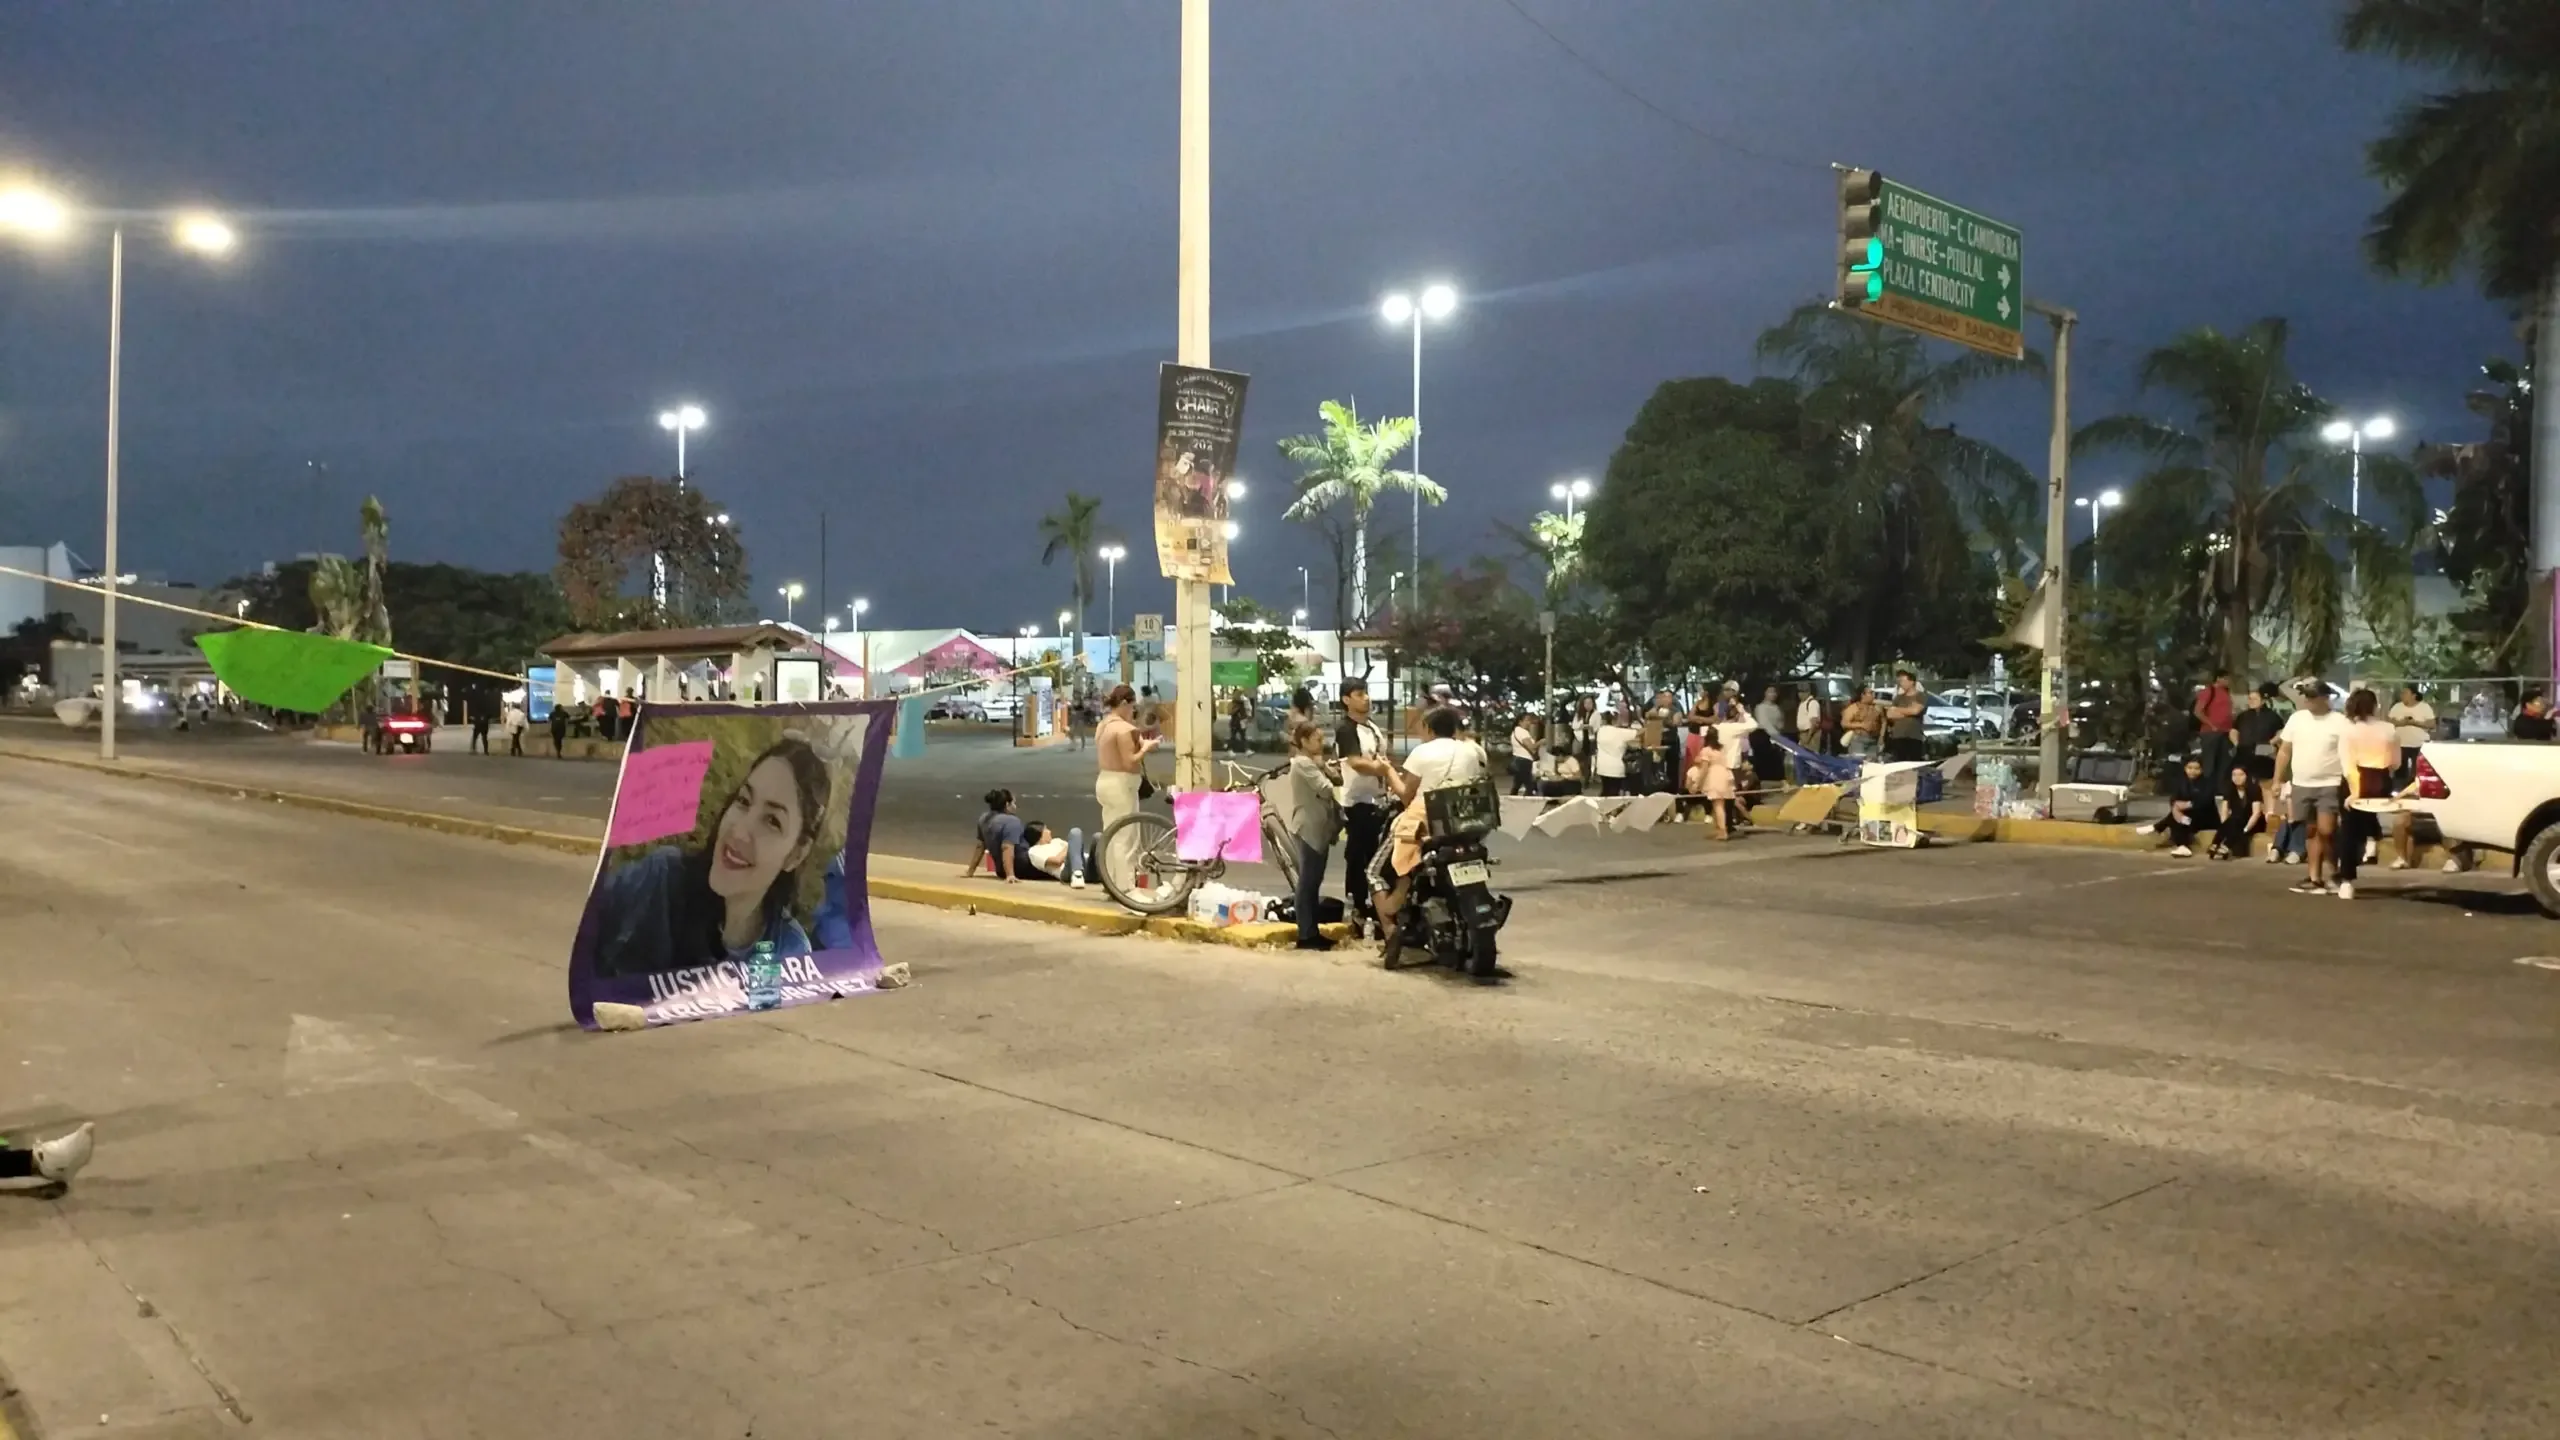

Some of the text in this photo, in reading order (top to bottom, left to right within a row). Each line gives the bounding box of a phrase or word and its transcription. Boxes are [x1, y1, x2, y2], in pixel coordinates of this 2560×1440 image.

[1883, 257, 1976, 309] PLAZA CENTROCITY
[780, 955, 824, 983] ARA
